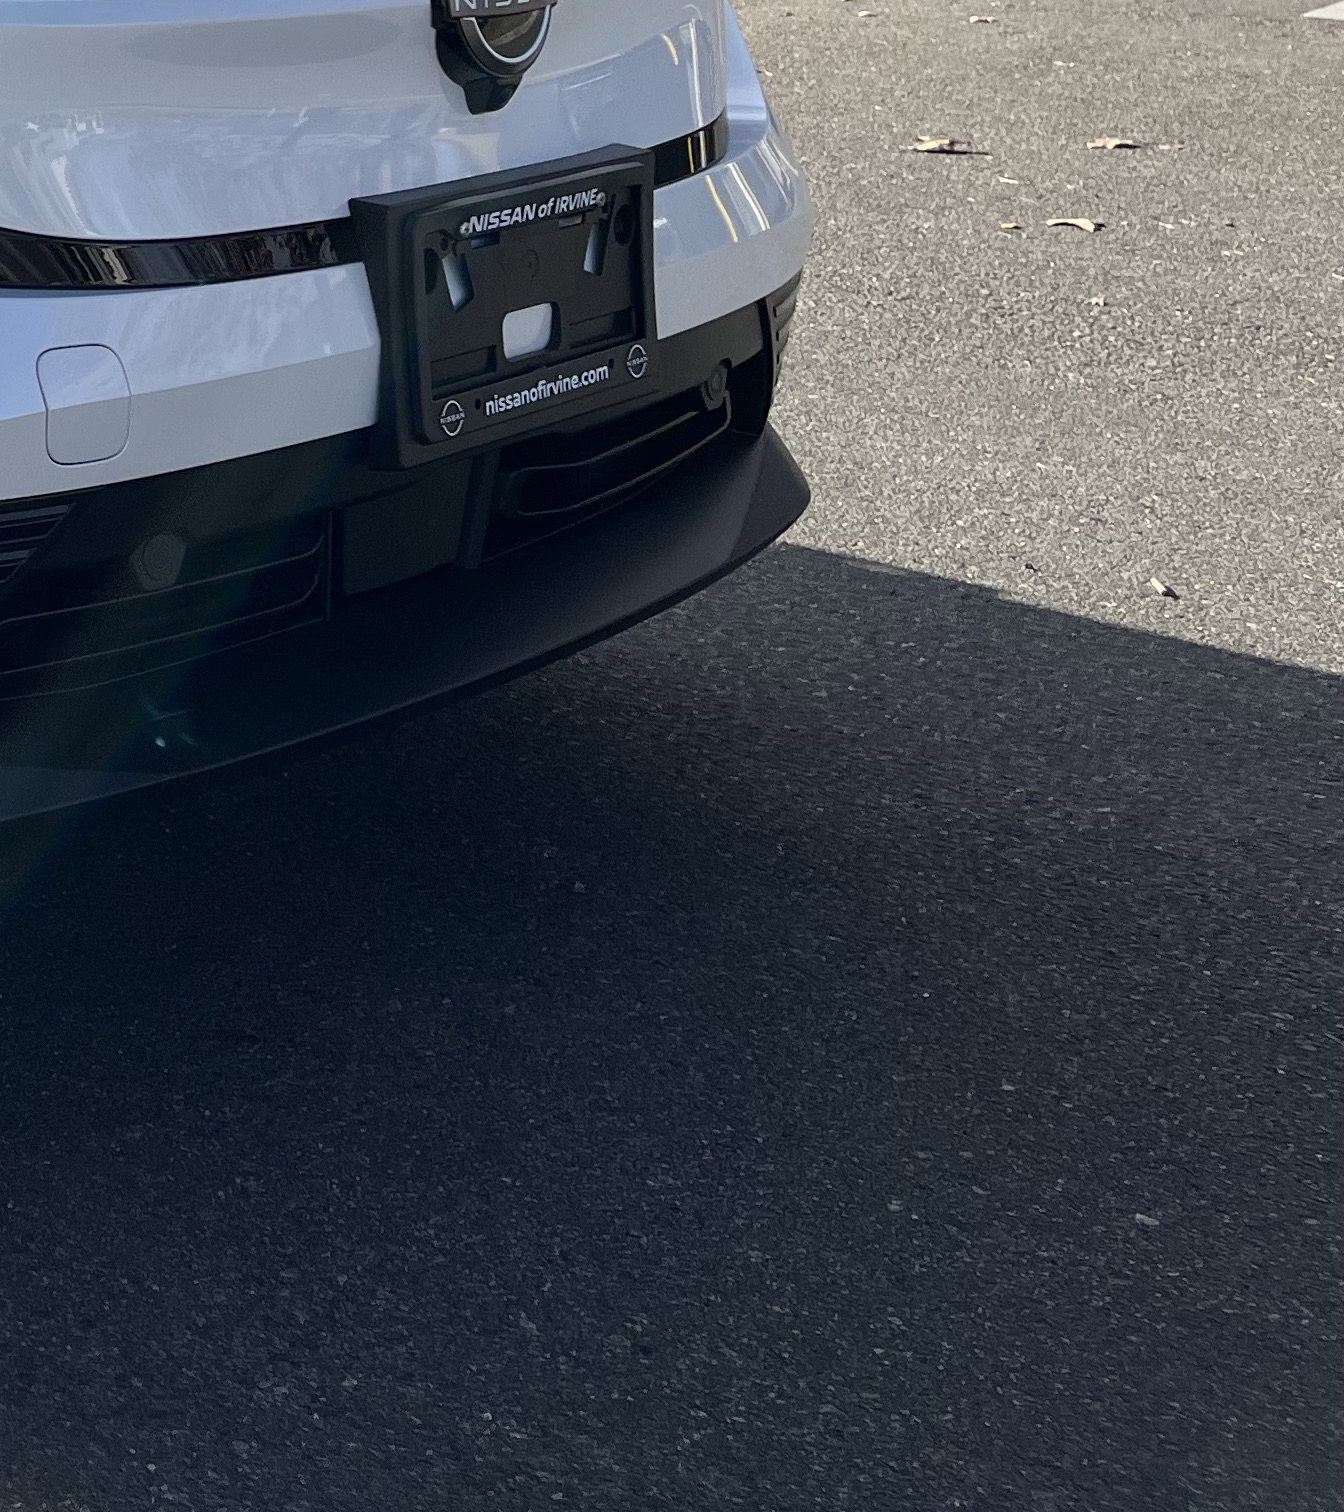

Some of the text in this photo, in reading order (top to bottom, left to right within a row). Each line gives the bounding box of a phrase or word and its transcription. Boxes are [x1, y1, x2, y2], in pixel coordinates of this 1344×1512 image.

[469, 188, 599, 234] NISSAN of IRVINE
[485, 364, 610, 416] nissanofirvine.com
